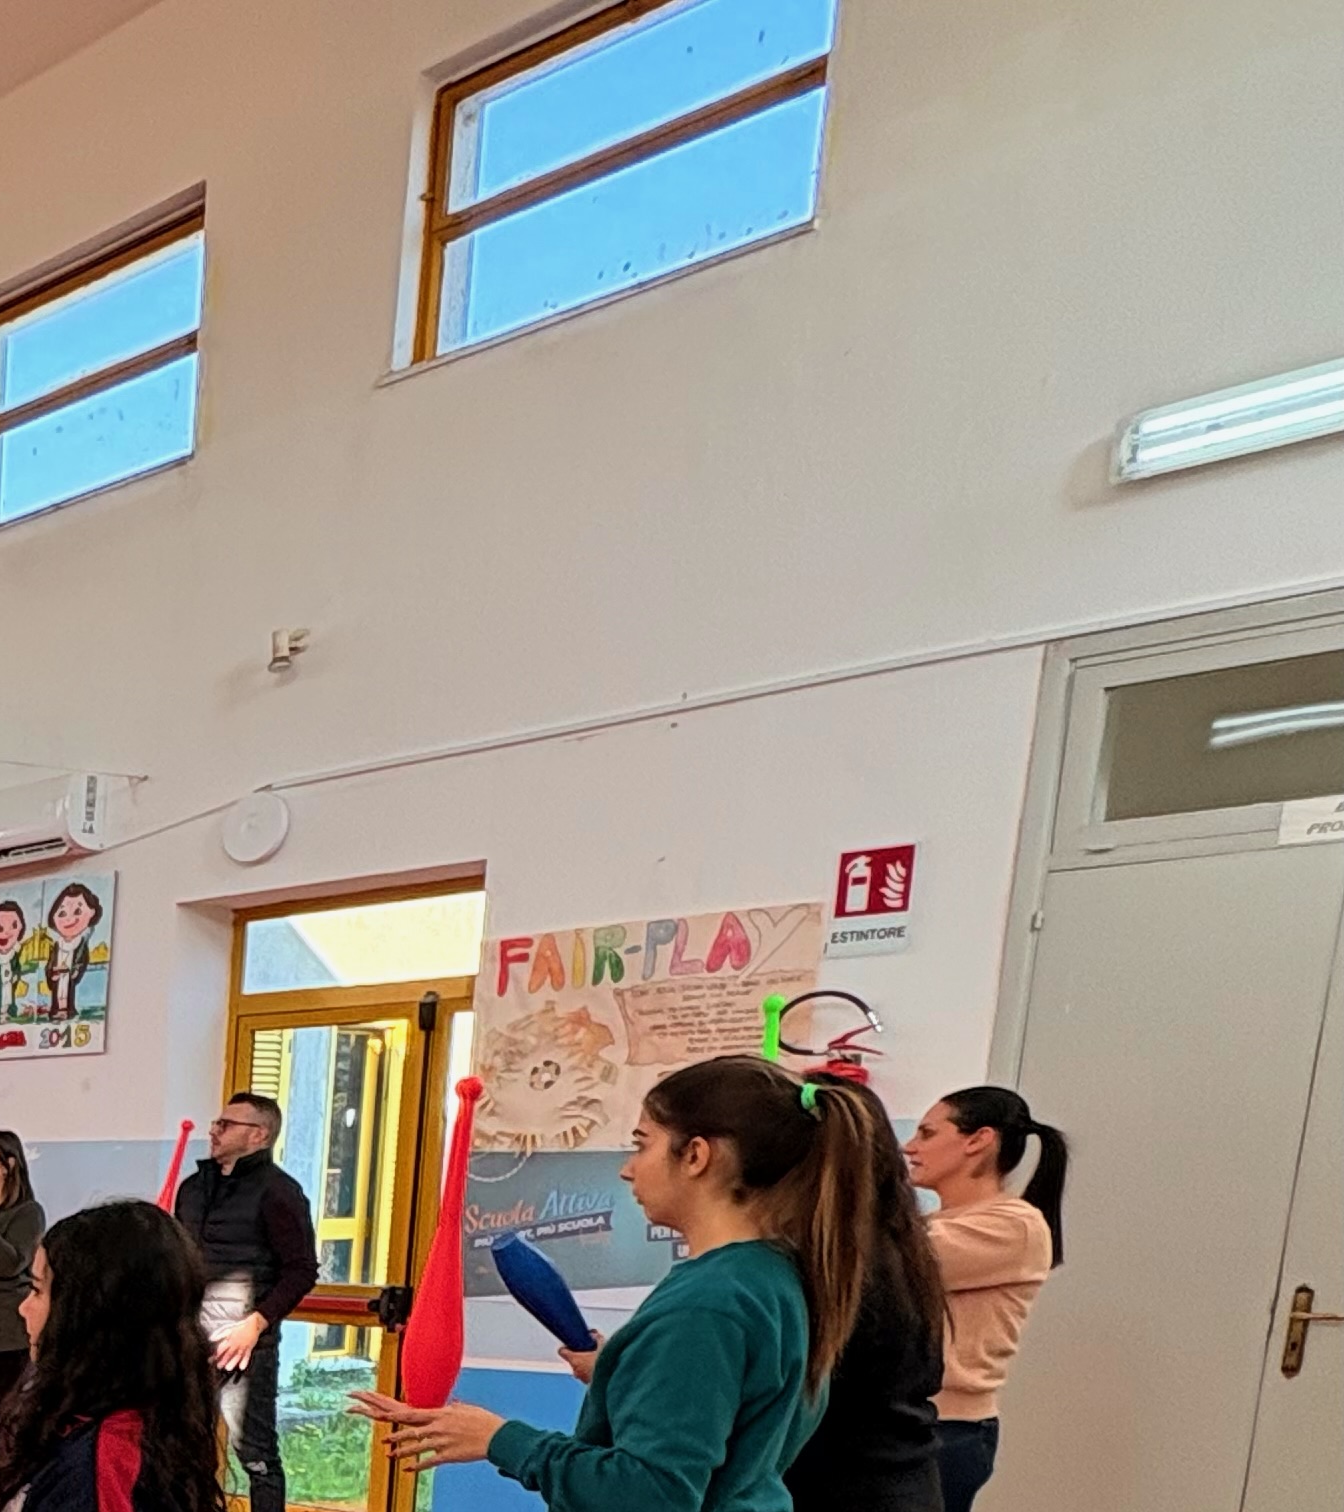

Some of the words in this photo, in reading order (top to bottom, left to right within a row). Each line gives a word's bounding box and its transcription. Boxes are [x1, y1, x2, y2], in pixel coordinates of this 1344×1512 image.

[1306, 821, 1344, 835] PRO
[830, 925, 907, 944] ESTINTORE
[496, 903, 811, 998] FAIR-PLAY
[38, 1024, 92, 1050] 2015
[464, 1199, 536, 1234] Scuola
[539, 1188, 613, 1220] Attiva
[558, 1216, 606, 1233] SCUOLA
